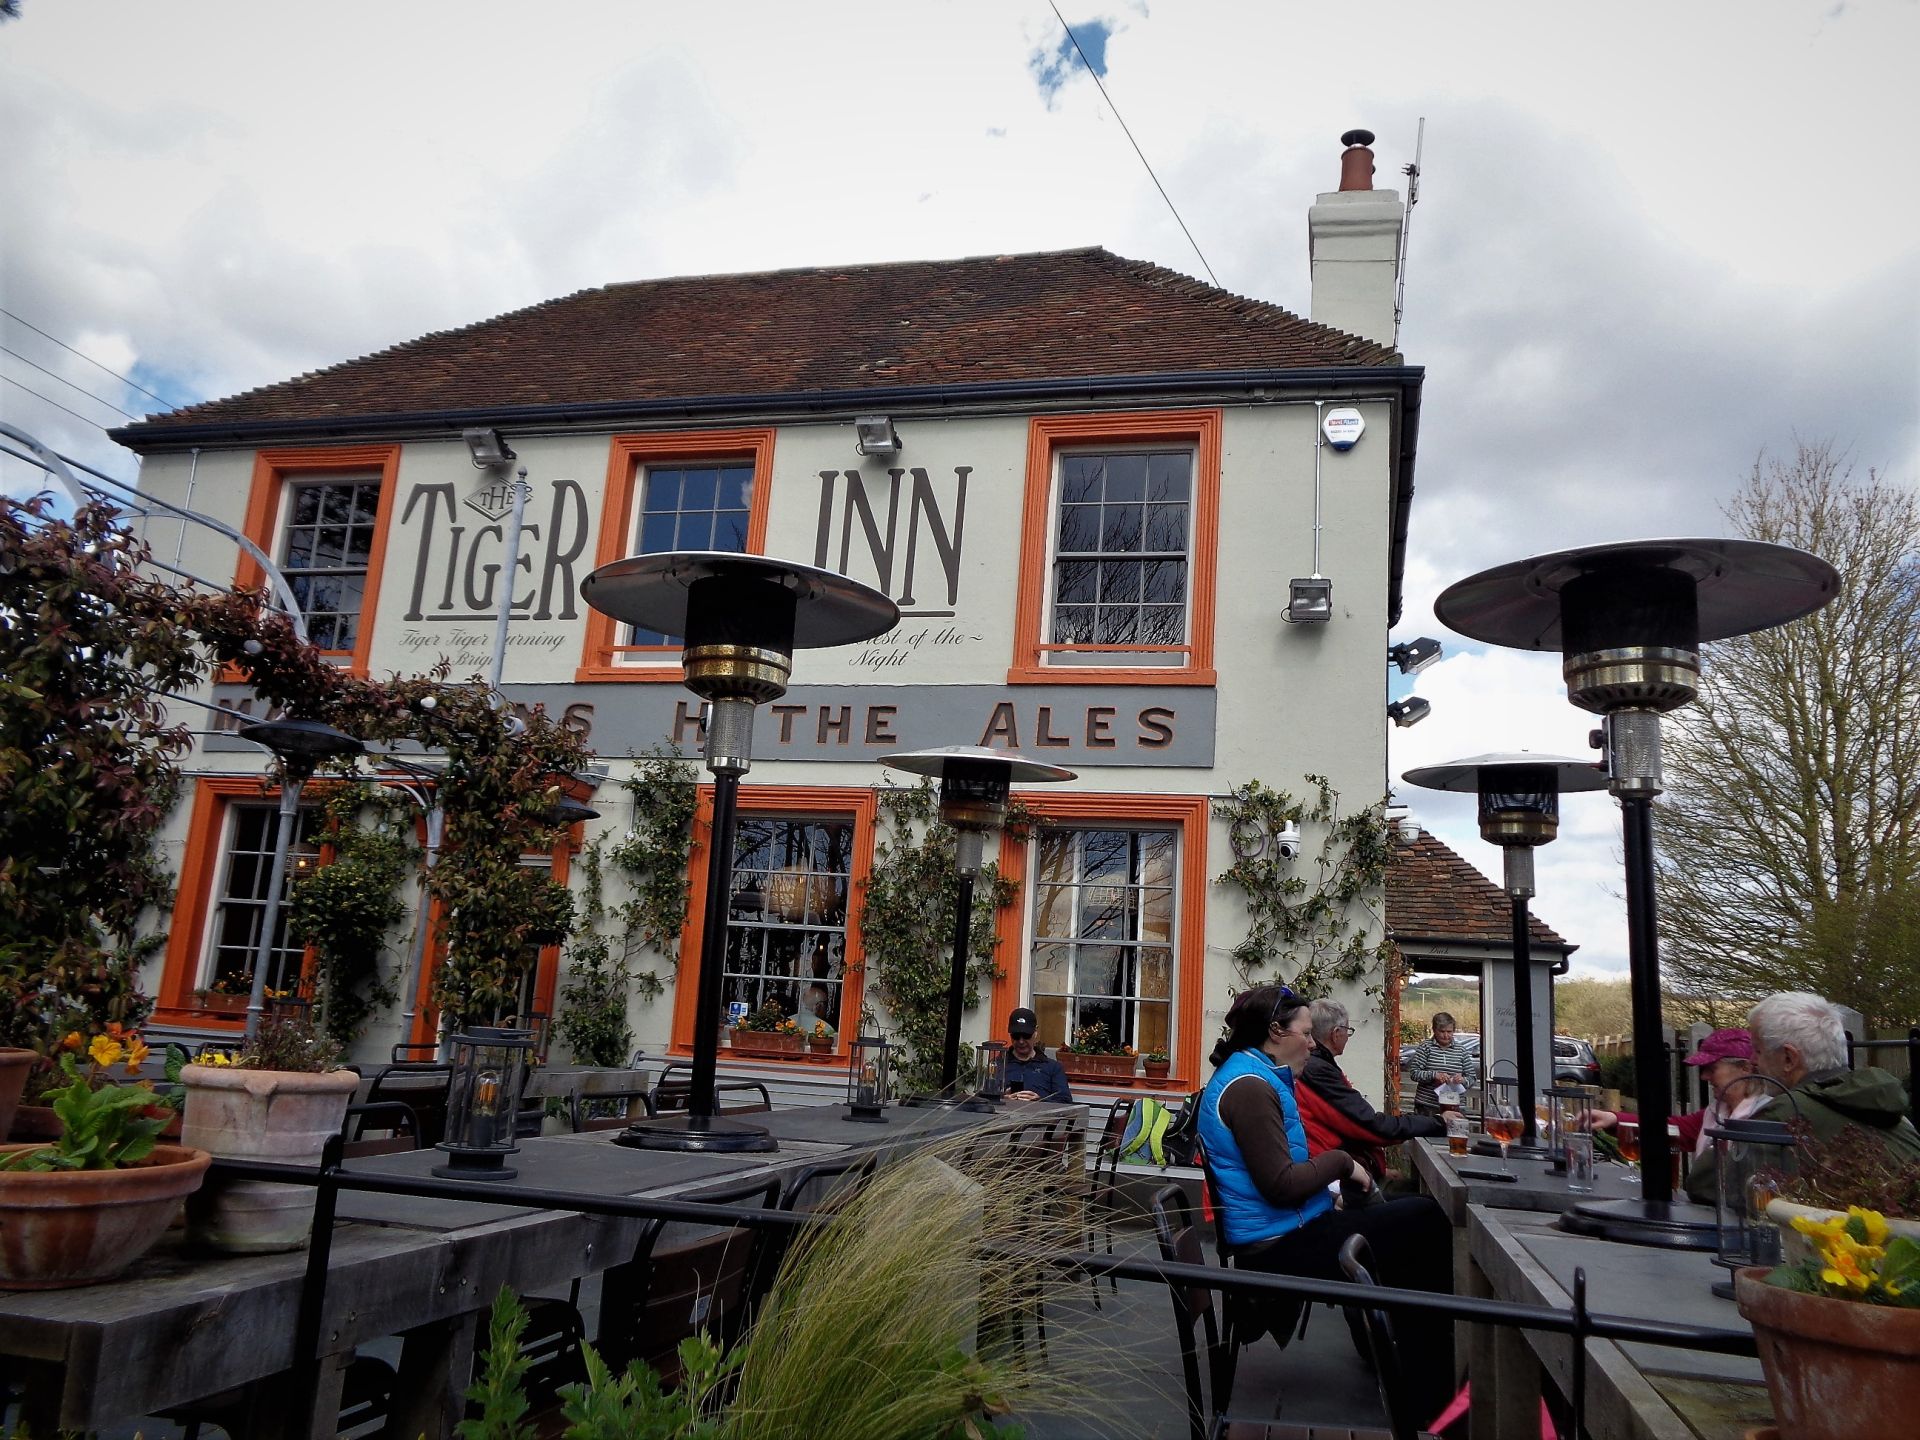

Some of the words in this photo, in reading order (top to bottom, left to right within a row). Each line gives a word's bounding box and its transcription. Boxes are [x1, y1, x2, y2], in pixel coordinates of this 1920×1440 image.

[480, 486, 515, 510] THE
[401, 480, 589, 621] TIGER
[813, 466, 974, 606] INN
[400, 629, 440, 653] Tiger
[446, 628, 488, 652] Tiger
[504, 631, 566, 652] urning
[904, 628, 929, 650] of
[451, 650, 493, 672] Brig
[848, 648, 910, 673] Night
[975, 701, 1176, 748] ALES
